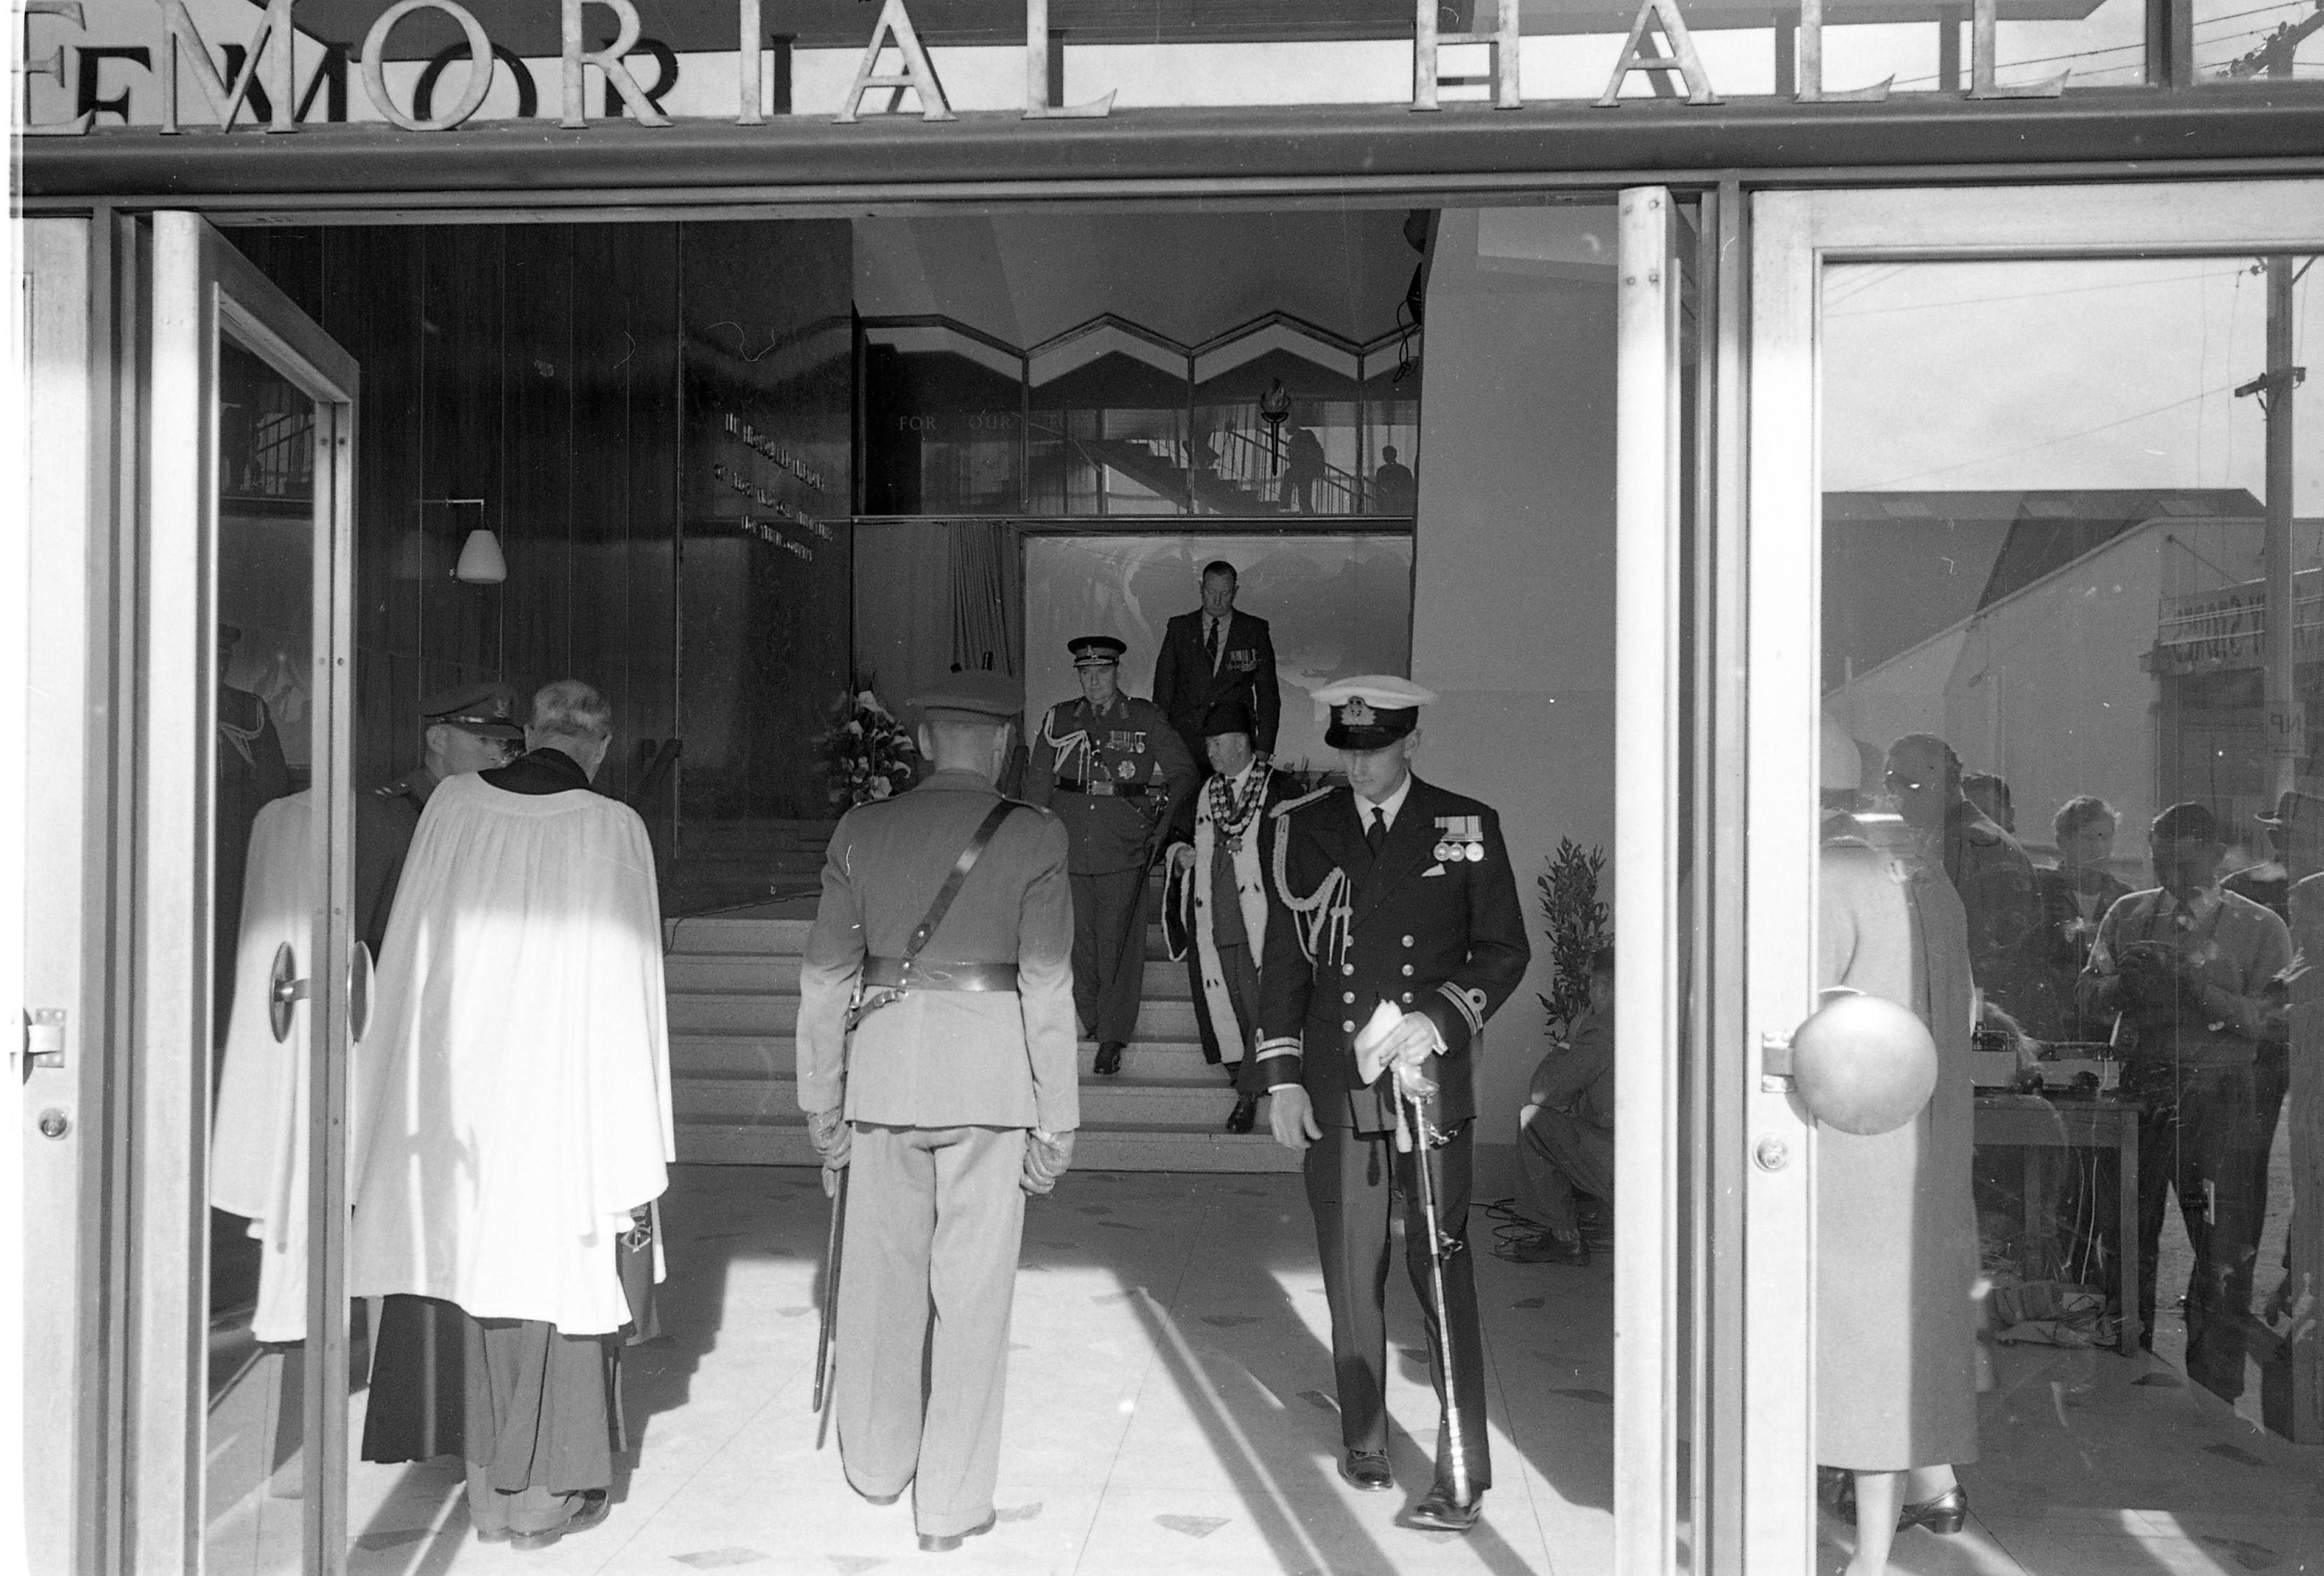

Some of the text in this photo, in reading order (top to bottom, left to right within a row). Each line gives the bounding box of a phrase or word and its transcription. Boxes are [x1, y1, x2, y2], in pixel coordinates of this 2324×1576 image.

[1409, 0, 2071, 111] HALL
[899, 414, 1015, 431] FOR OUR
